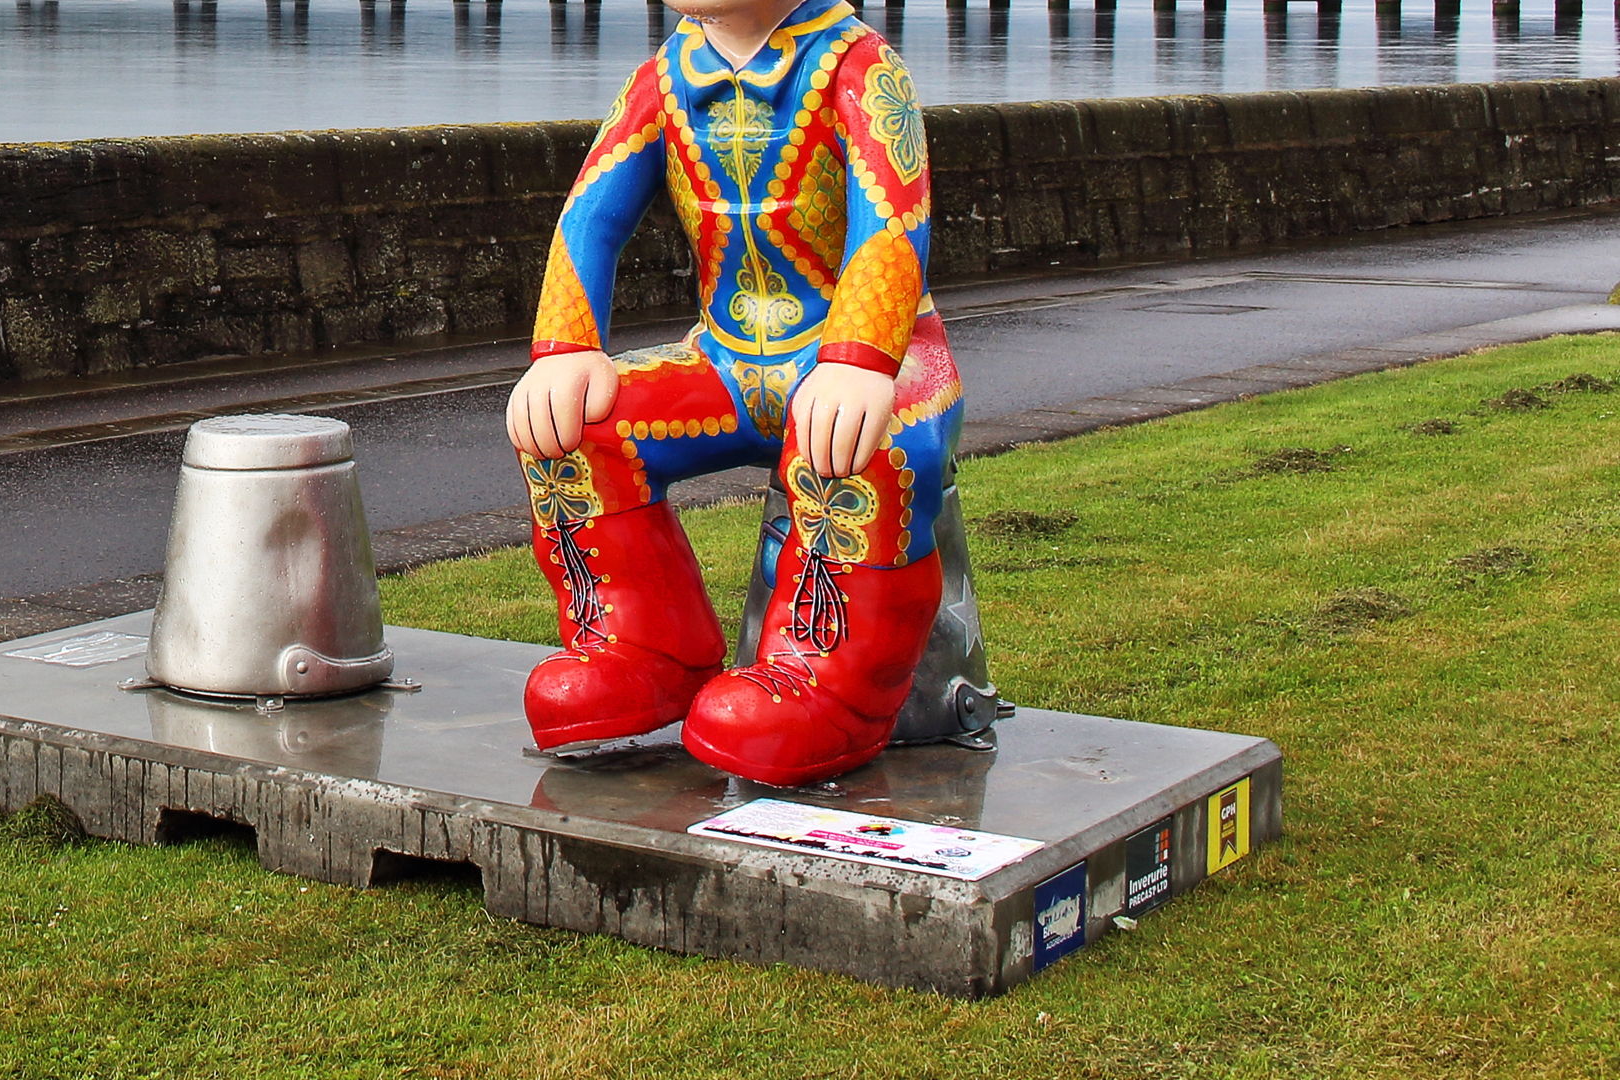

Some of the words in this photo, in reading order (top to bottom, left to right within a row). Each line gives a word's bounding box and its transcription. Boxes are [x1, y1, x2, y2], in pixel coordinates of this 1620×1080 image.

[1221, 802, 1236, 820] CPH
[1128, 885, 1157, 909] PRECAST
[1157, 879, 1168, 894] LTD
[1129, 863, 1168, 896] Inverurie
